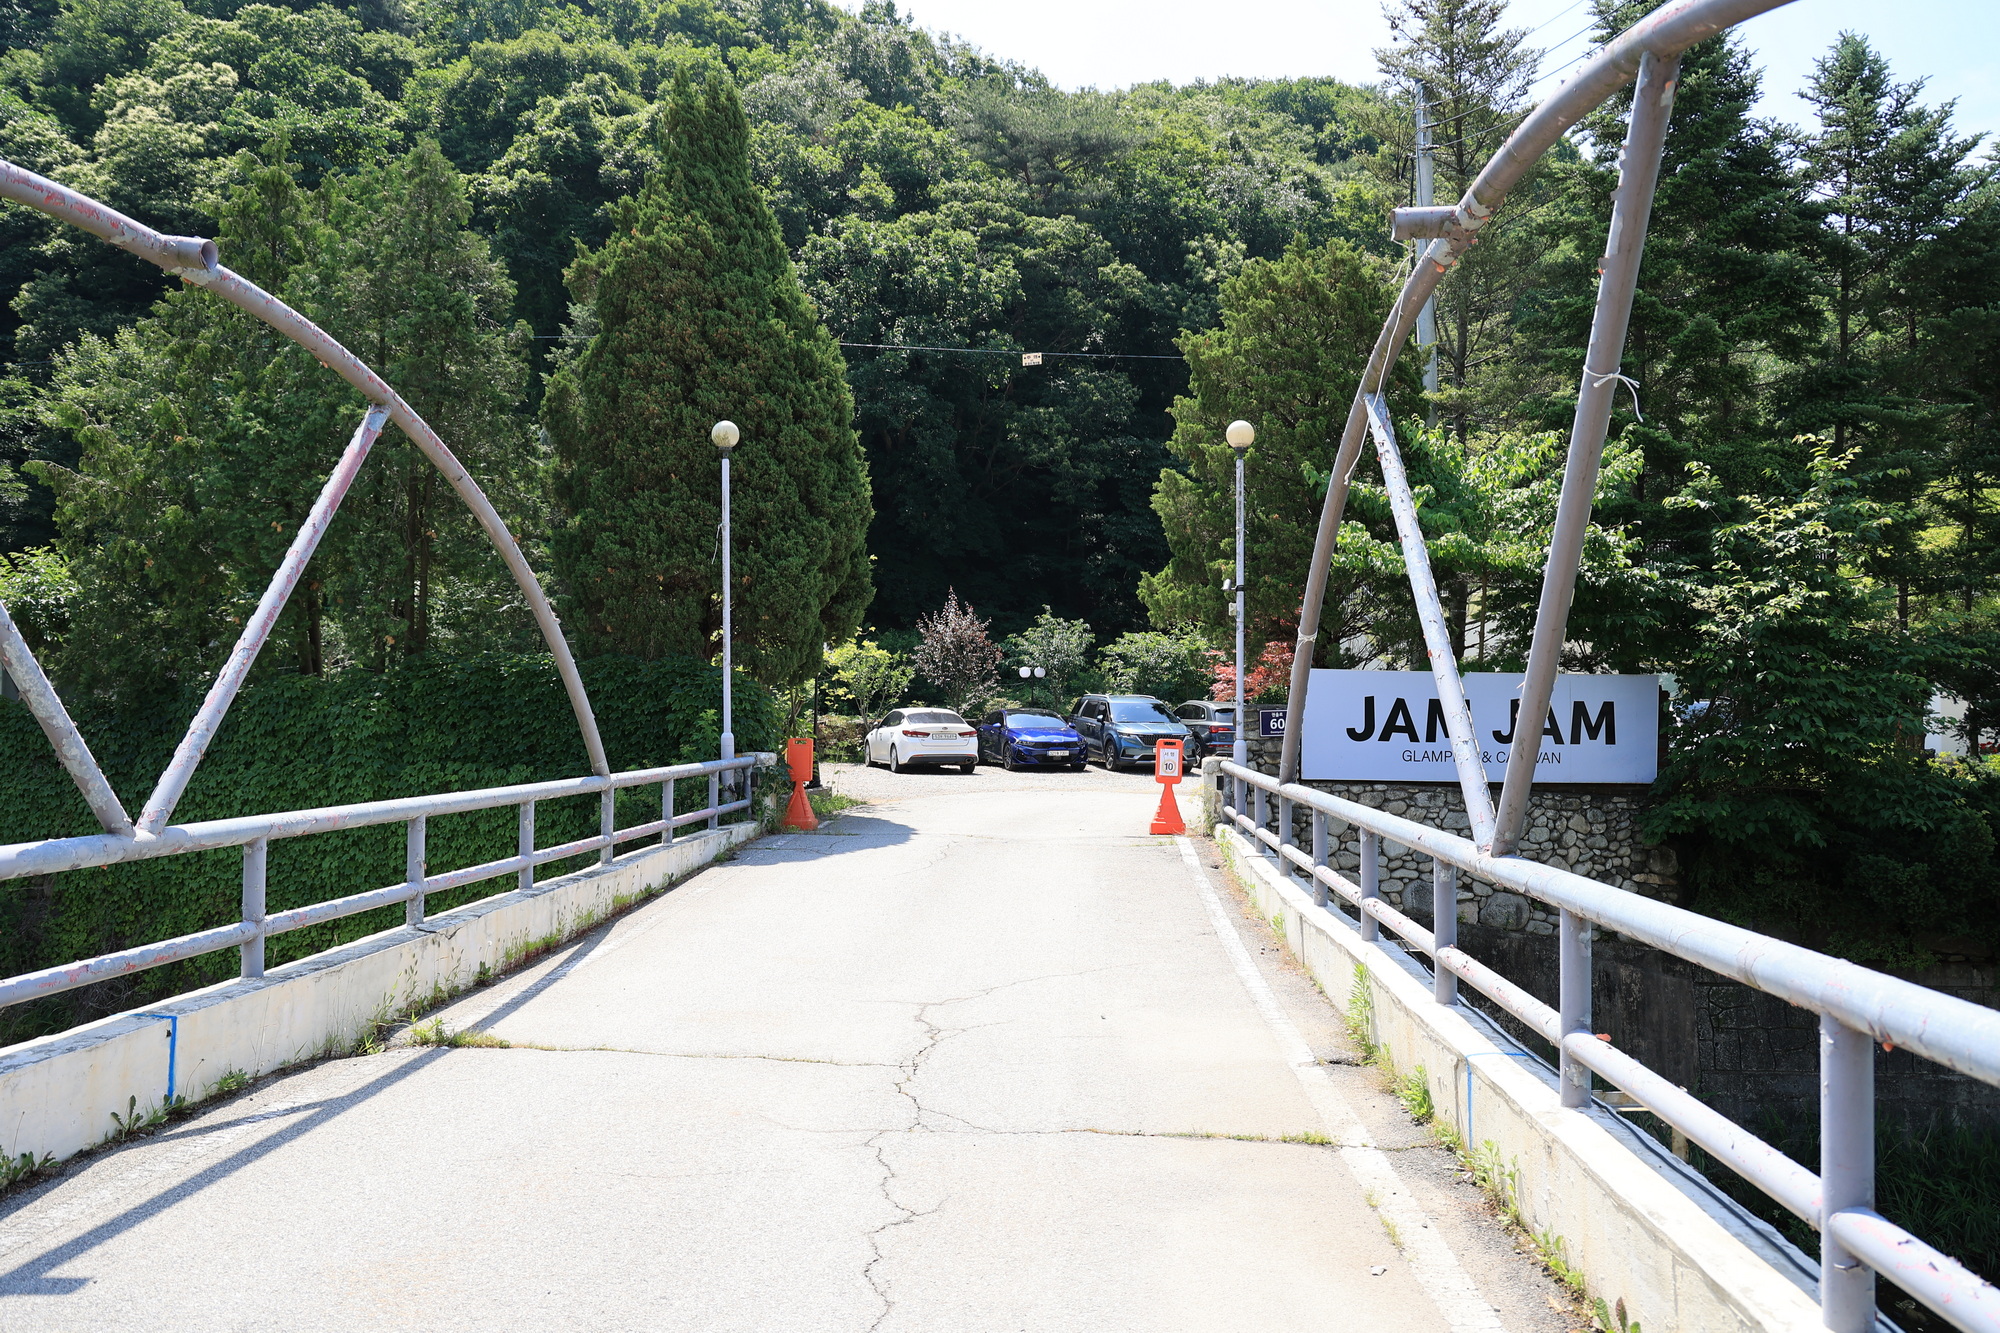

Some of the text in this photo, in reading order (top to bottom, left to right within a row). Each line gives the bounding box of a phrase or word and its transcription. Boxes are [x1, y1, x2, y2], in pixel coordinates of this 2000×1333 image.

[1270, 718, 1285, 730] 60
[1402, 749, 1456, 763] GLAMP
[1481, 751, 1492, 764] &
[1164, 762, 1174, 771] 10
